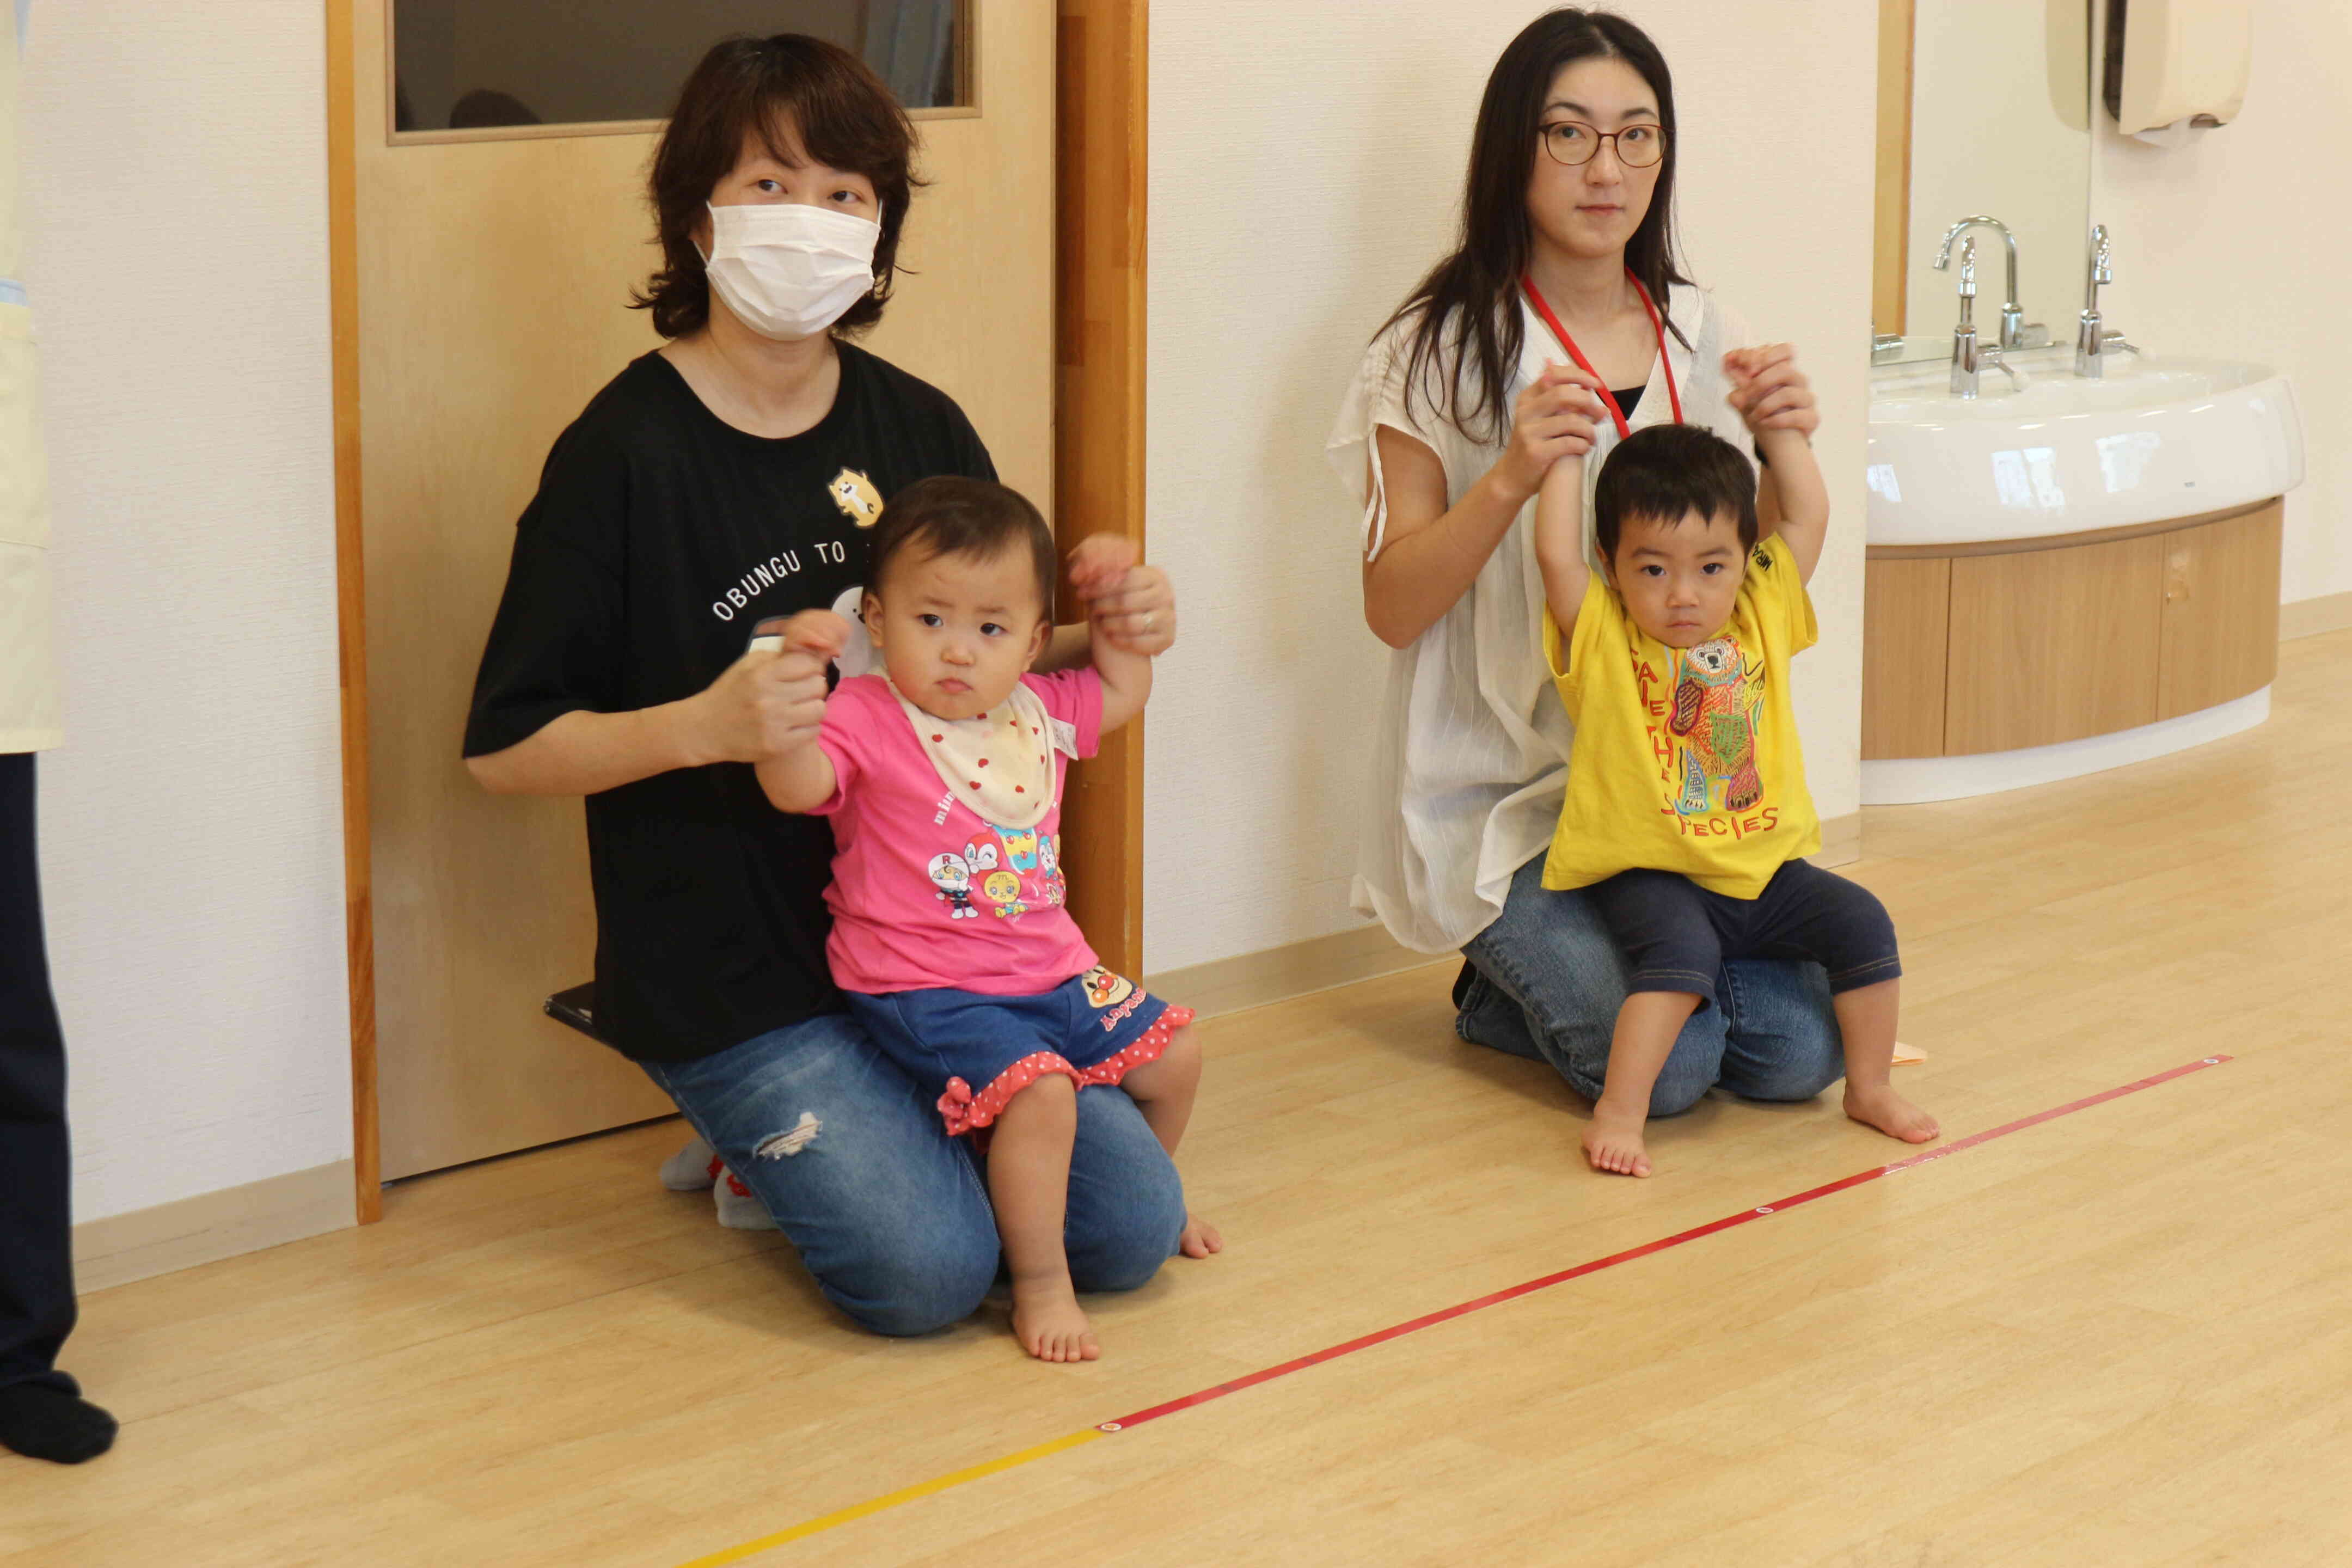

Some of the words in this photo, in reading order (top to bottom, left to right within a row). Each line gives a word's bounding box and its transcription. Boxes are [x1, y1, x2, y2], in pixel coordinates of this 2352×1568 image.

[713, 550, 801, 621] OBUNGU
[814, 541, 845, 564] TO
[1661, 792, 1779, 840] SPECIES
[942, 855, 951, 865] R
